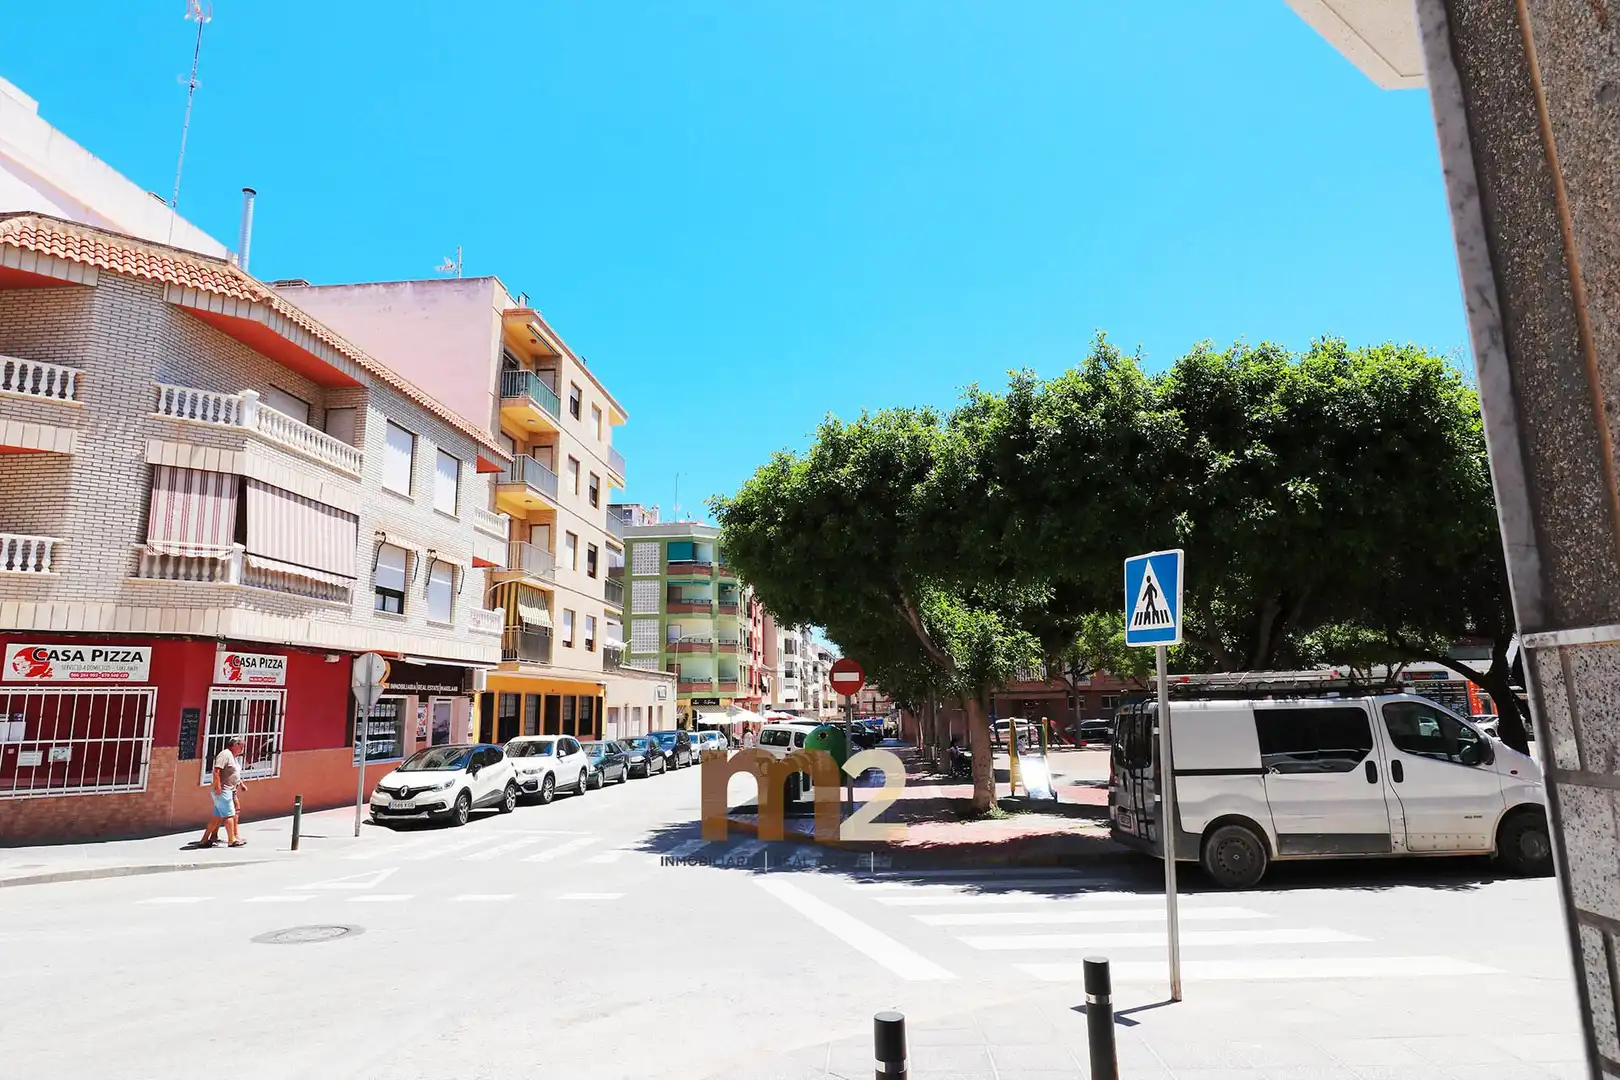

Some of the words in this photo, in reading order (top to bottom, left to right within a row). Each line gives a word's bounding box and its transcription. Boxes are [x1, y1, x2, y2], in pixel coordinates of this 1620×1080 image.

[33, 648, 84, 661] CASA
[91, 649, 143, 662] PIZZA
[232, 656, 257, 668] CASA
[260, 657, 283, 669] PIZZA
